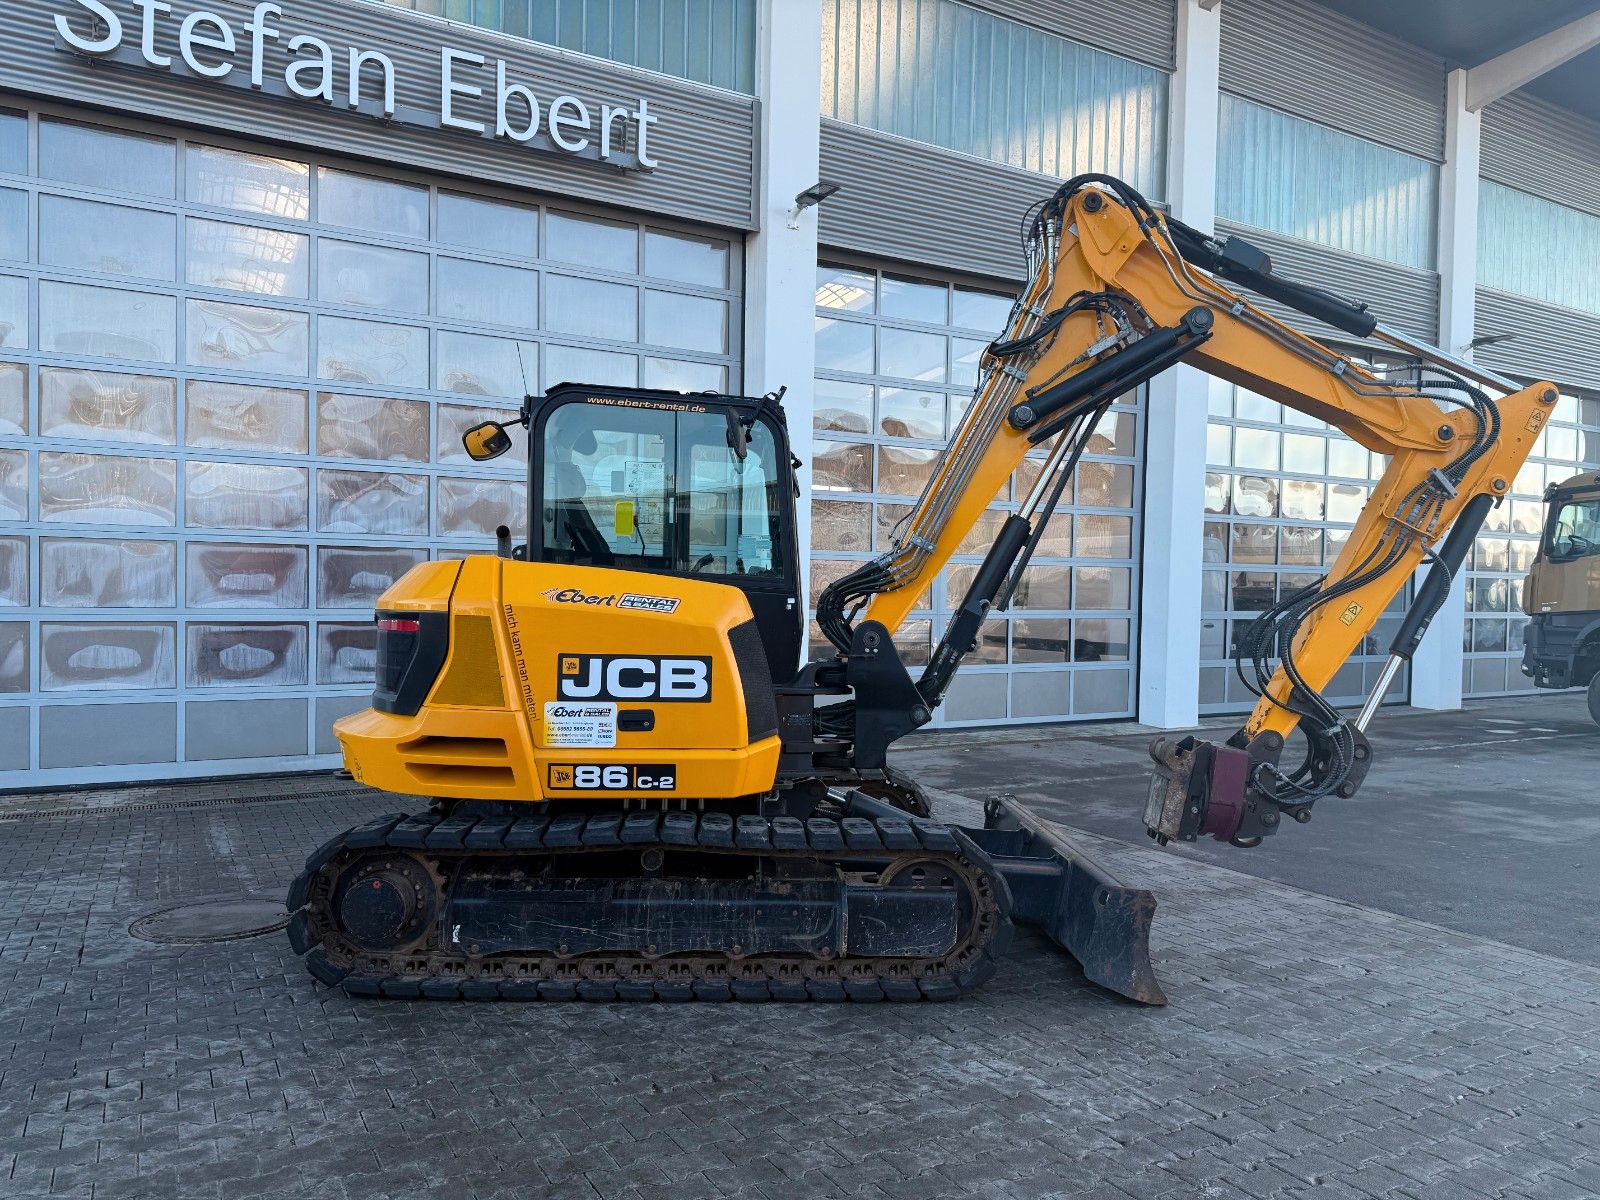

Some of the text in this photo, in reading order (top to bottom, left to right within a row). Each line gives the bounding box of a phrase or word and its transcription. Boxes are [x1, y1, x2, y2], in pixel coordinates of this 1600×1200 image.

[53, 0, 657, 170] Stefan Ebert
[587, 397, 706, 413] www.ebert-rental.de
[556, 588, 617, 607] Ebert
[624, 596, 674, 606] RENTAL
[504, 603, 541, 723] mich kann man mieten!
[561, 658, 709, 698] JCB
[554, 706, 584, 718] Ebert
[553, 769, 571, 783] JCB
[574, 765, 674, 788] 86 C-2
